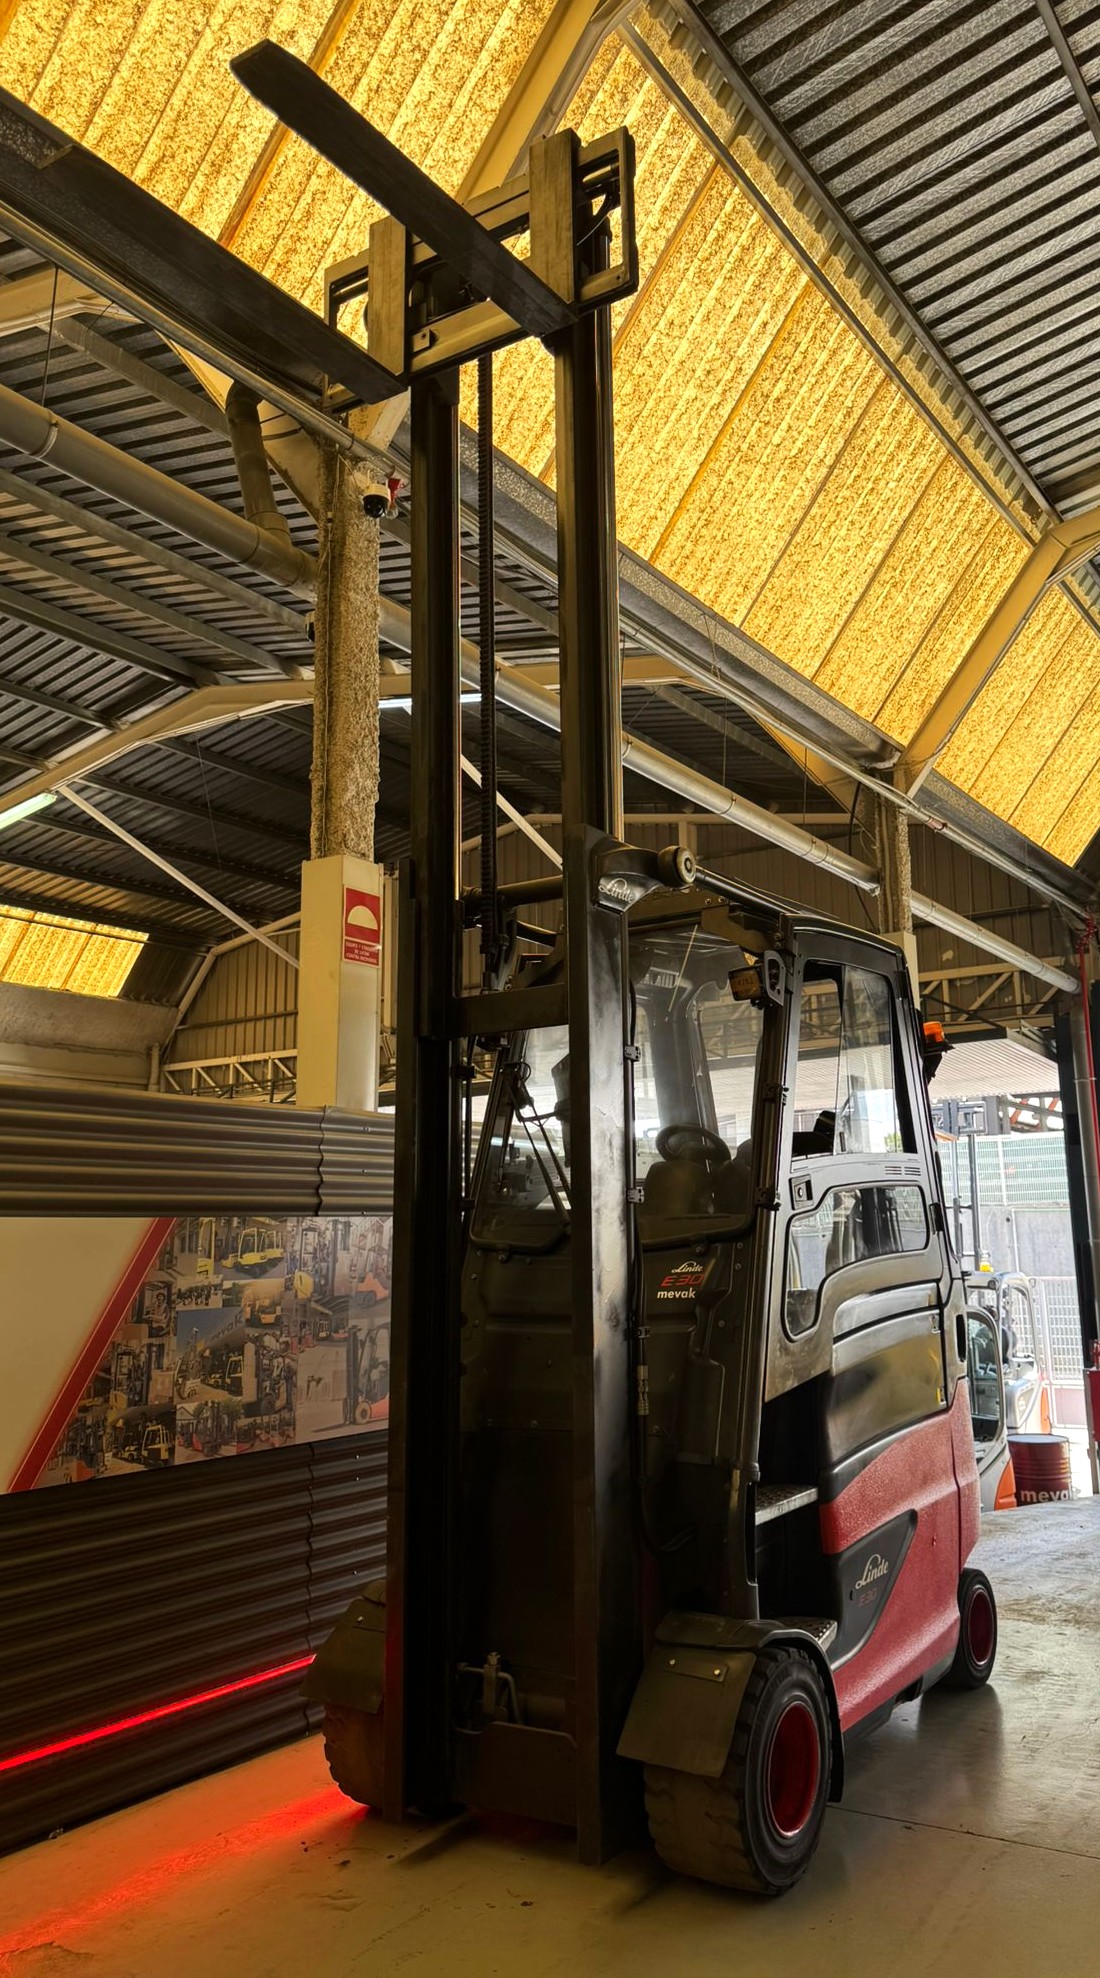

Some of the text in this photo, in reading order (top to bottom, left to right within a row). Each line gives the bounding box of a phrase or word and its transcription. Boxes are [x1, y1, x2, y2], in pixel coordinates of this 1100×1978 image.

[598, 877, 633, 903] Linde
[671, 1260, 704, 1273] Linde
[659, 1274, 705, 1288] E30
[656, 1287, 696, 1299] mevak
[855, 1553, 889, 1590] Linde
